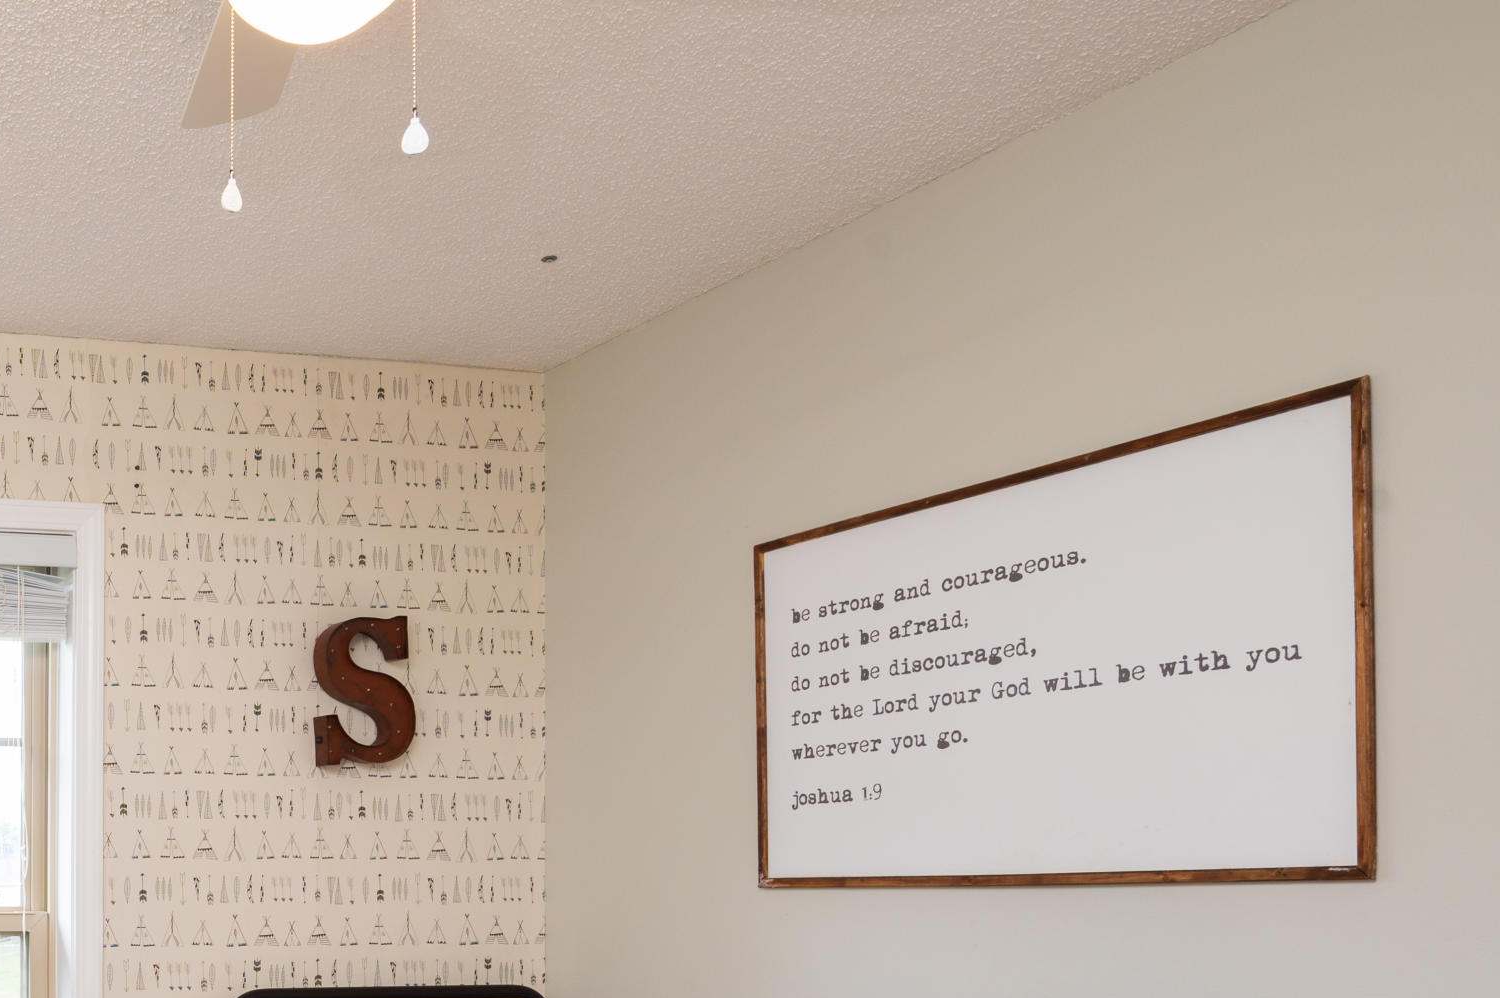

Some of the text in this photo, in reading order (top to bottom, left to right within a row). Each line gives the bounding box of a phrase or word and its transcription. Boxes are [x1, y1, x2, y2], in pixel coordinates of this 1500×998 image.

[790, 550, 1087, 625] be strong and courageous.
[790, 609, 969, 659] do not be afraid;
[313, 615, 416, 767] S
[791, 637, 1037, 693] do not be discouraged,
[791, 644, 1303, 727] for the Lord your God will be with you
[791, 729, 969, 761] wherever you go.
[791, 783, 883, 811] joshua 1:9
